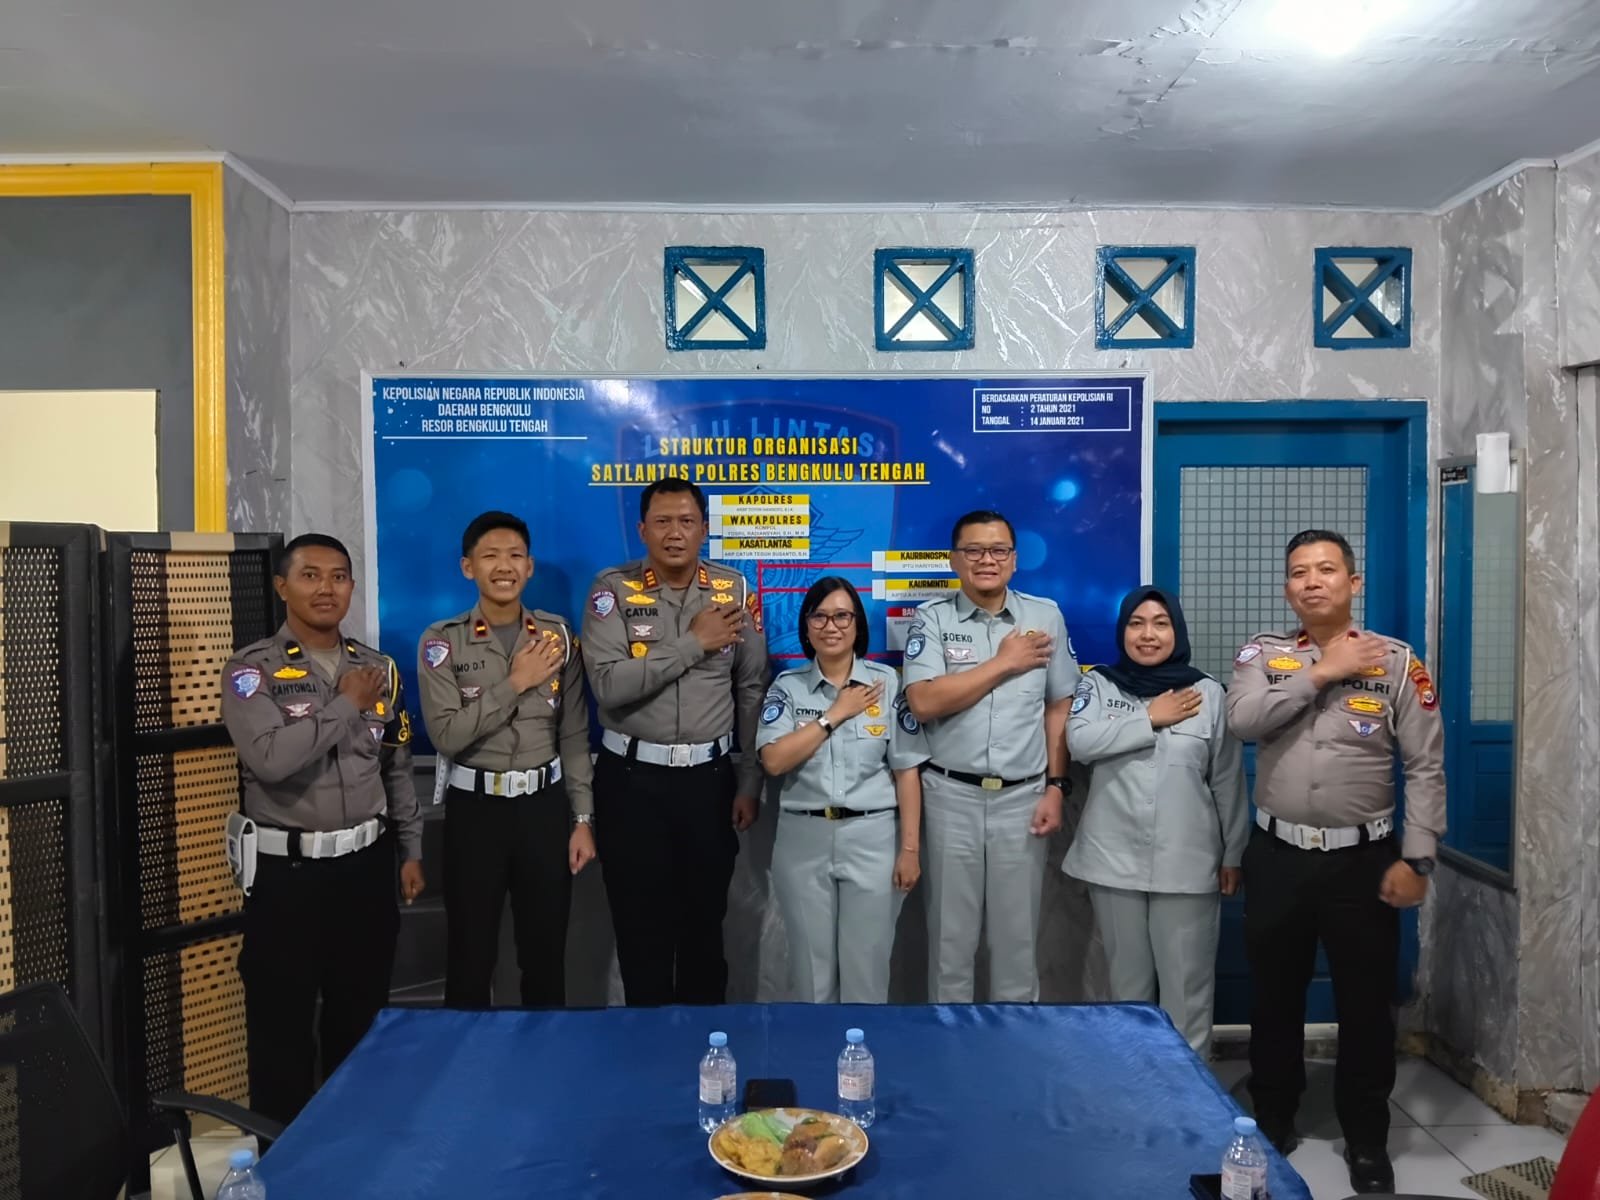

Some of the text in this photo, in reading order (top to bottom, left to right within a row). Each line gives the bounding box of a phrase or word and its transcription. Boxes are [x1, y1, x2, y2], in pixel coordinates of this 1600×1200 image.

[383, 387, 585, 401] KEPOLISIAN NEGARA REPUBLIK INDONESIA
[981, 393, 1113, 403] BERDASARKAN PERATURAN KEPOLISIAN RI
[438, 404, 531, 417] DAERAH BENGKULU
[981, 405, 991, 414] NO
[1030, 404, 1035, 413] 2
[1036, 404, 1058, 413] TAHUN
[1058, 404, 1076, 413] 2021
[421, 419, 548, 433] RESOR BENGKULU TENGAH
[981, 416, 1010, 425] TANGGAL
[1030, 417, 1038, 426] 14
[1039, 417, 1066, 426] JANUARI
[1067, 416, 1084, 425] 2021
[659, 437, 859, 456] STRUKTUR ORGANISASI
[591, 462, 925, 482] SATLANTAS POLRES BENGKULU TENGAH
[738, 495, 793, 505] KAPOLRES
[730, 515, 802, 525] WAKAPOLRES
[739, 539, 793, 549] KASATLANTAS
[900, 551, 953, 561] KAURBINOSPNA
[908, 579, 949, 589] KAURMINTU
[625, 607, 659, 617] CATUR
[943, 633, 973, 643] SOEKO
[453, 663, 470, 673] IMO
[1342, 678, 1390, 694] POLRI
